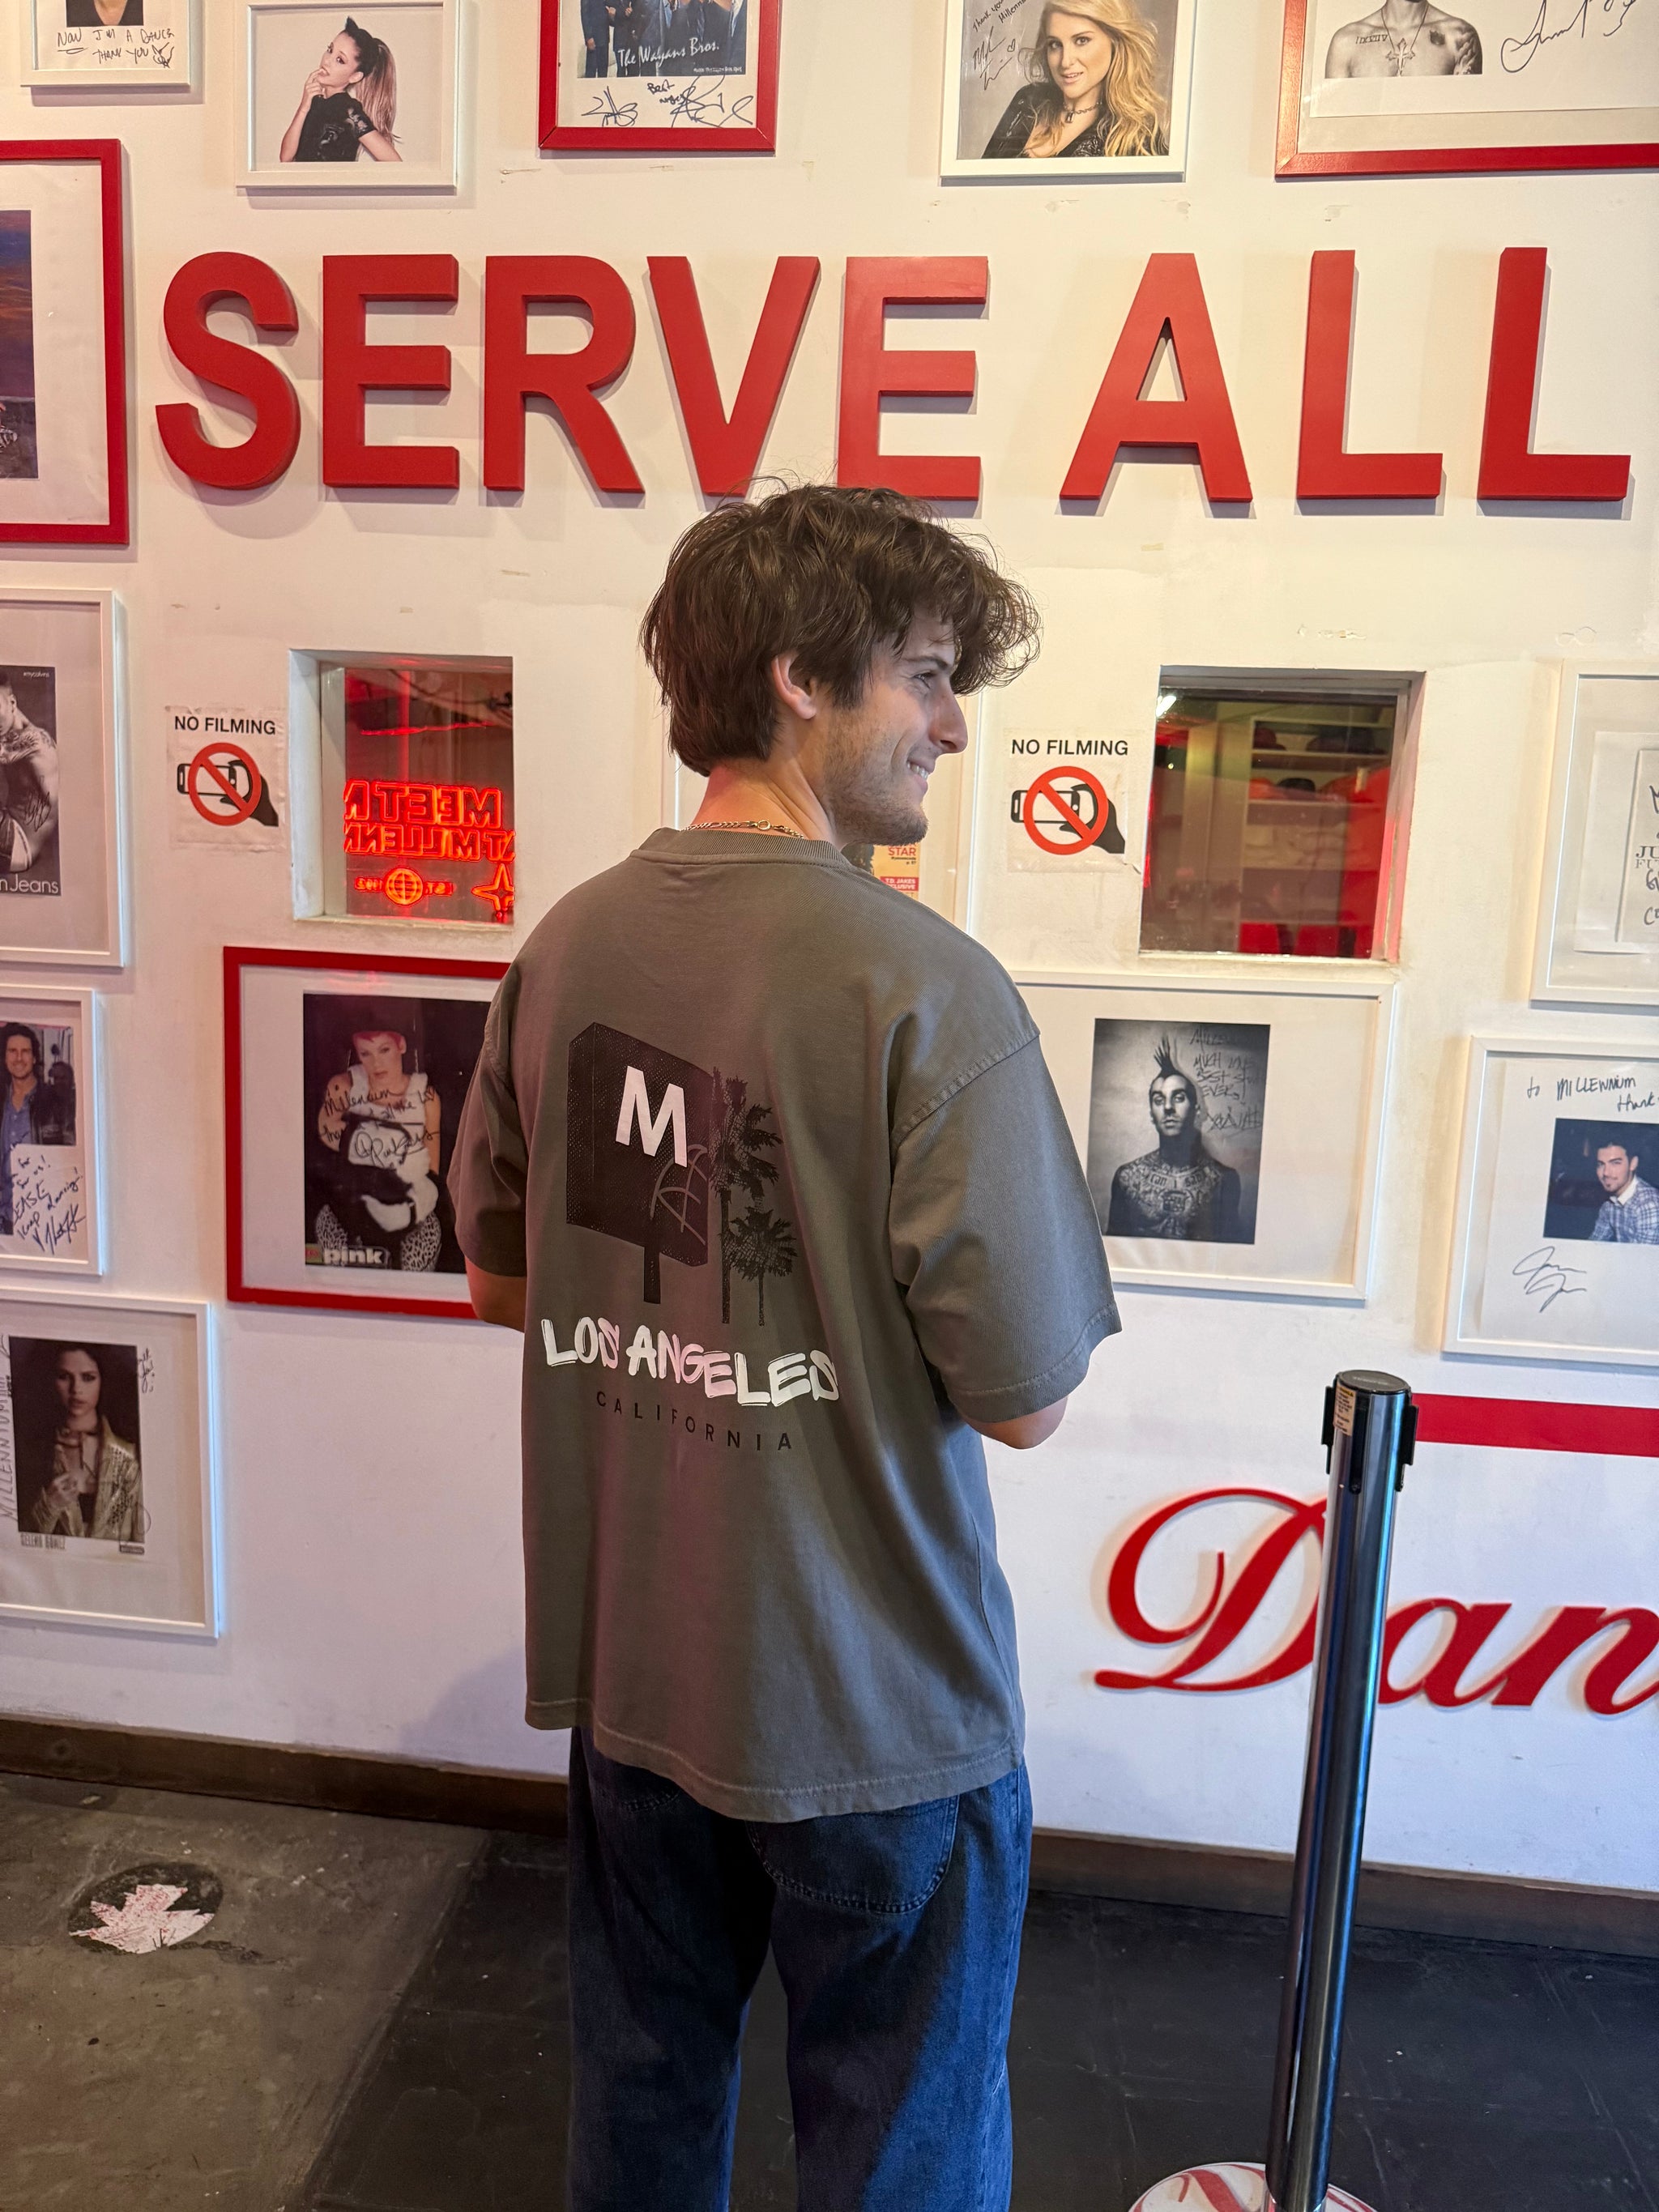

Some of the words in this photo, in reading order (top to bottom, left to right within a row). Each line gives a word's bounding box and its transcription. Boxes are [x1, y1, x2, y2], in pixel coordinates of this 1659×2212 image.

[617, 49, 637, 67] The
[638, 45, 686, 67] Wayans
[689, 37, 720, 57] Bros.
[156, 251, 1000, 501] SERVE
[1059, 247, 1631, 502] ALL
[174, 716, 199, 731] NO
[204, 718, 276, 735] FILMING
[1012, 739, 1040, 754] NO
[1047, 739, 1128, 755] FILMING
[888, 847, 917, 856] STAR
[10, 873, 58, 893] Jeans
[615, 1065, 688, 1168] M
[324, 1247, 383, 1265] pink
[540, 1316, 621, 1370] LOS
[625, 1324, 841, 1408] ANGELES
[596, 1391, 792, 1451] CALIFORNIA
